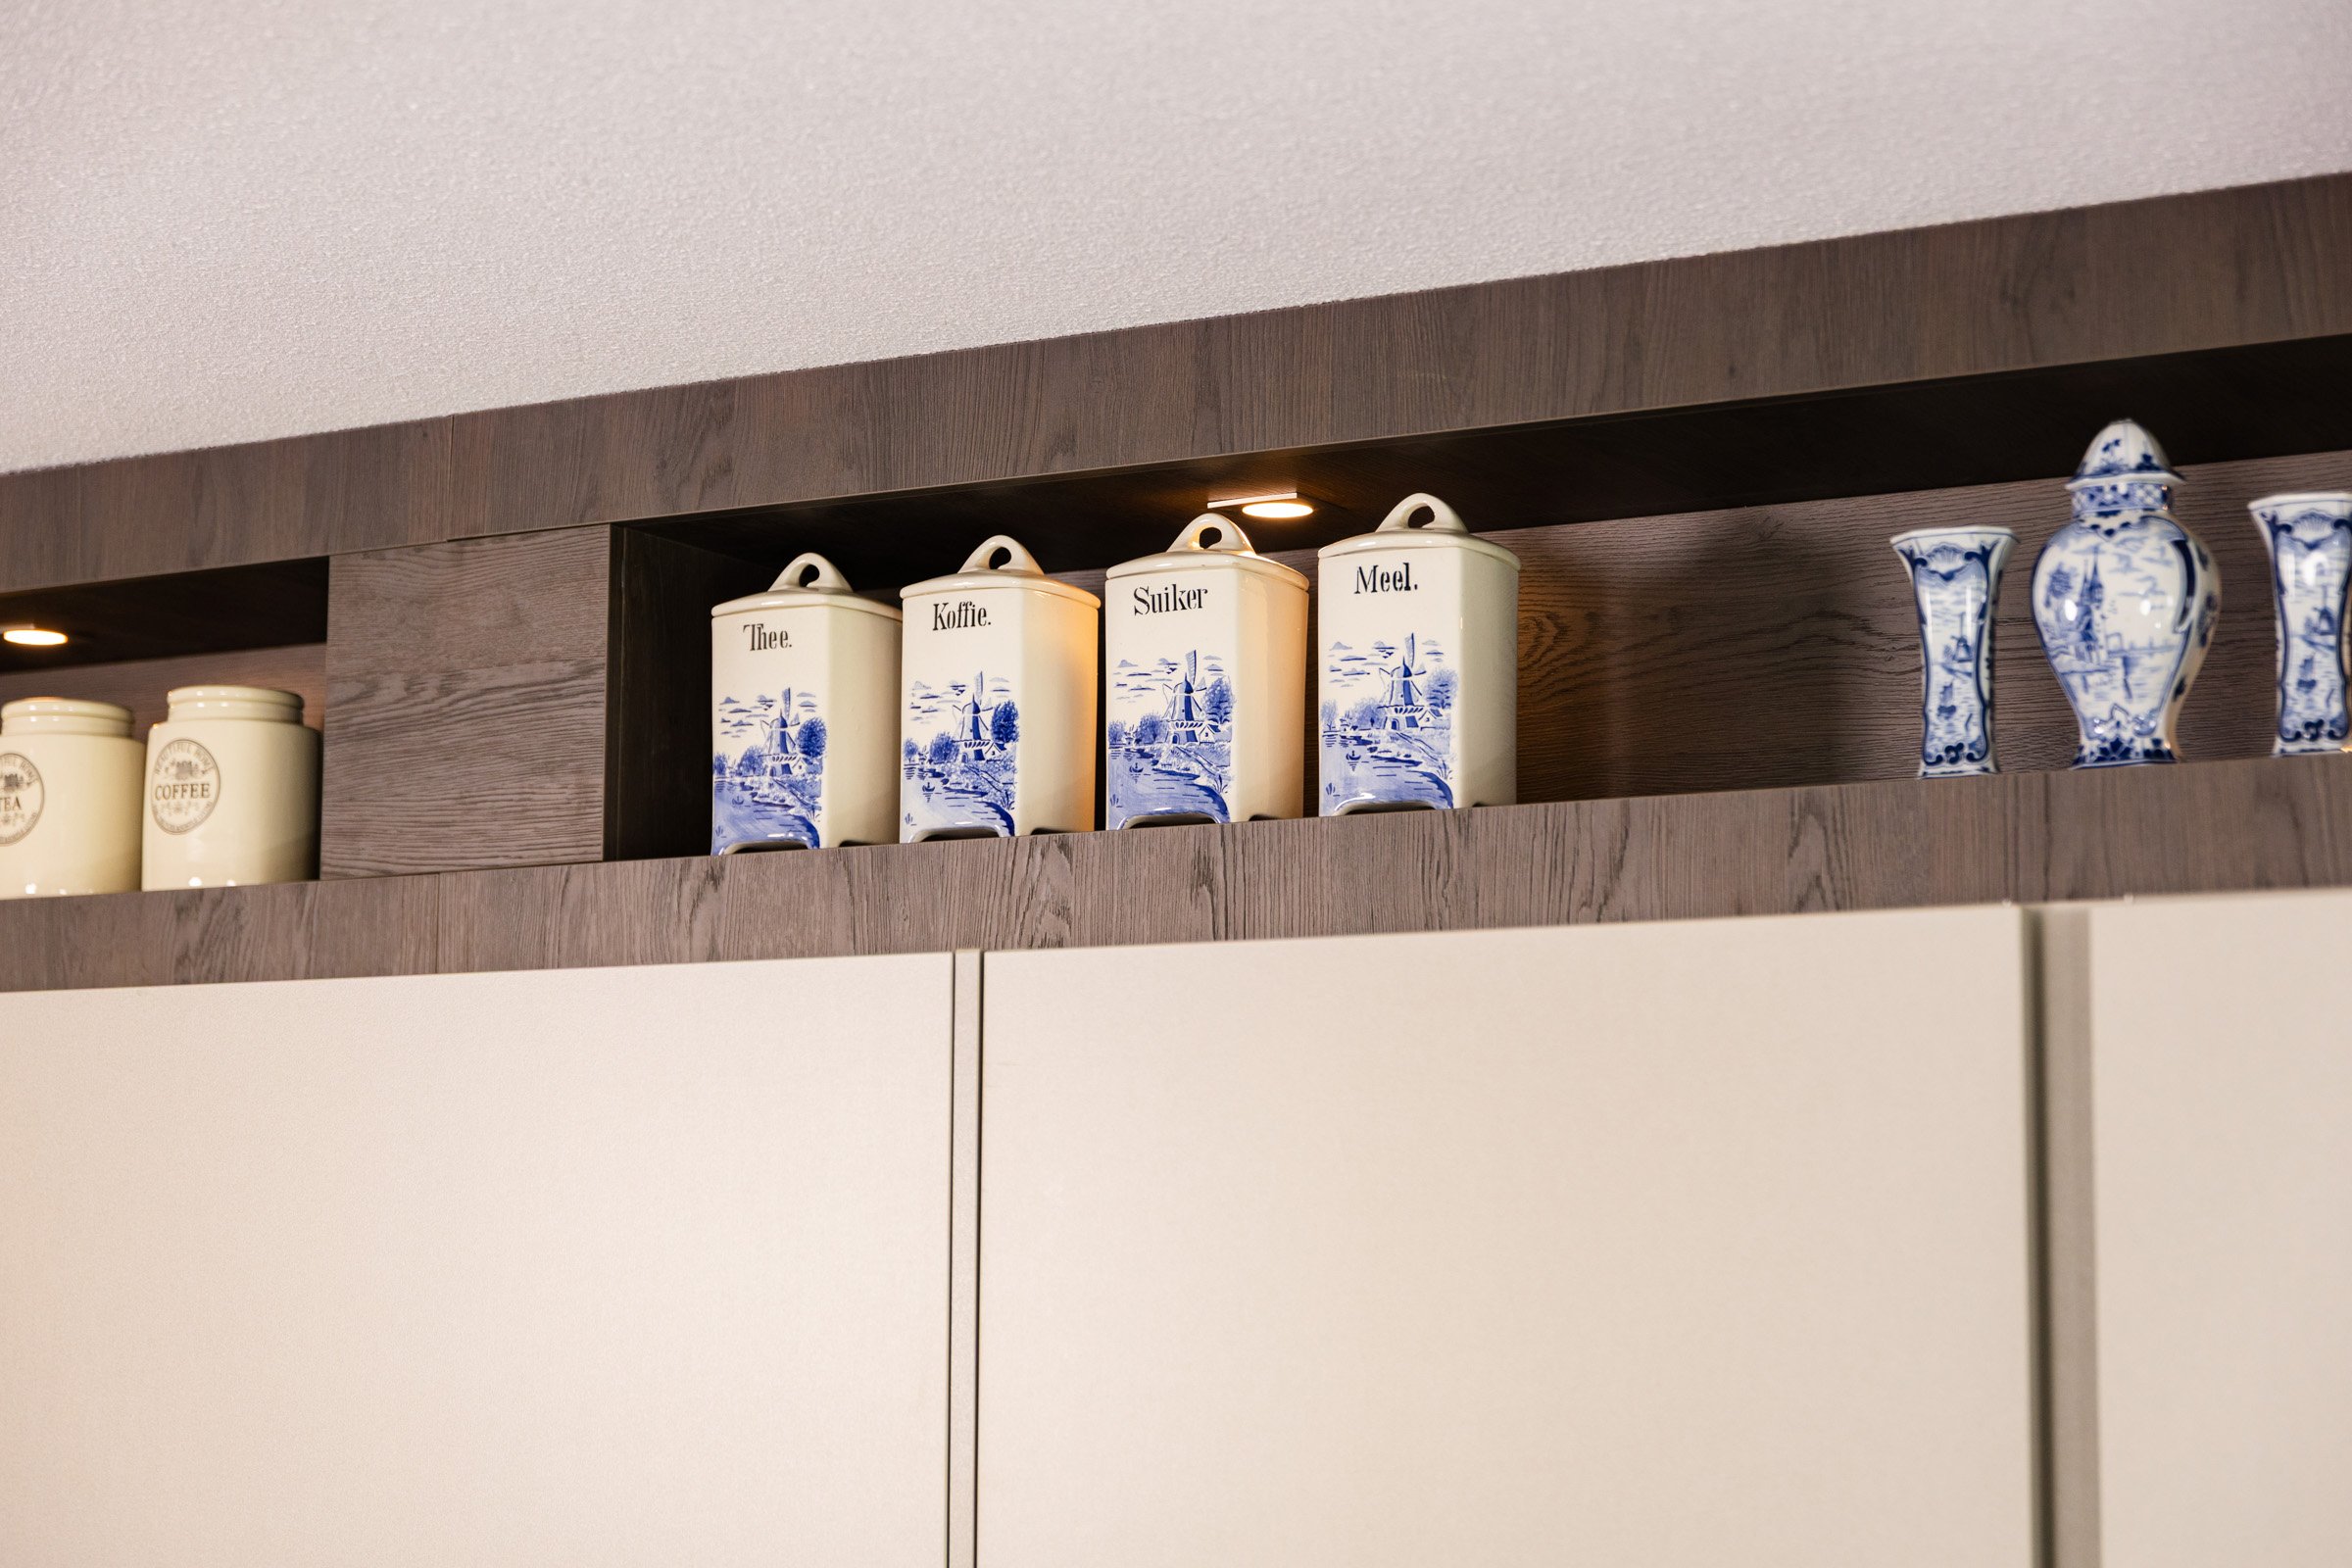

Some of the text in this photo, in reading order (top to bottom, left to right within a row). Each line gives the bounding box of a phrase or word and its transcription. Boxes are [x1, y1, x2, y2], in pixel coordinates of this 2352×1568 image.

[1353, 562, 1418, 595] Meel.
[1133, 583, 1208, 616] Suiker
[933, 601, 992, 631] Koffie.
[743, 623, 792, 651] Thee.
[155, 783, 211, 801] COFFEE
